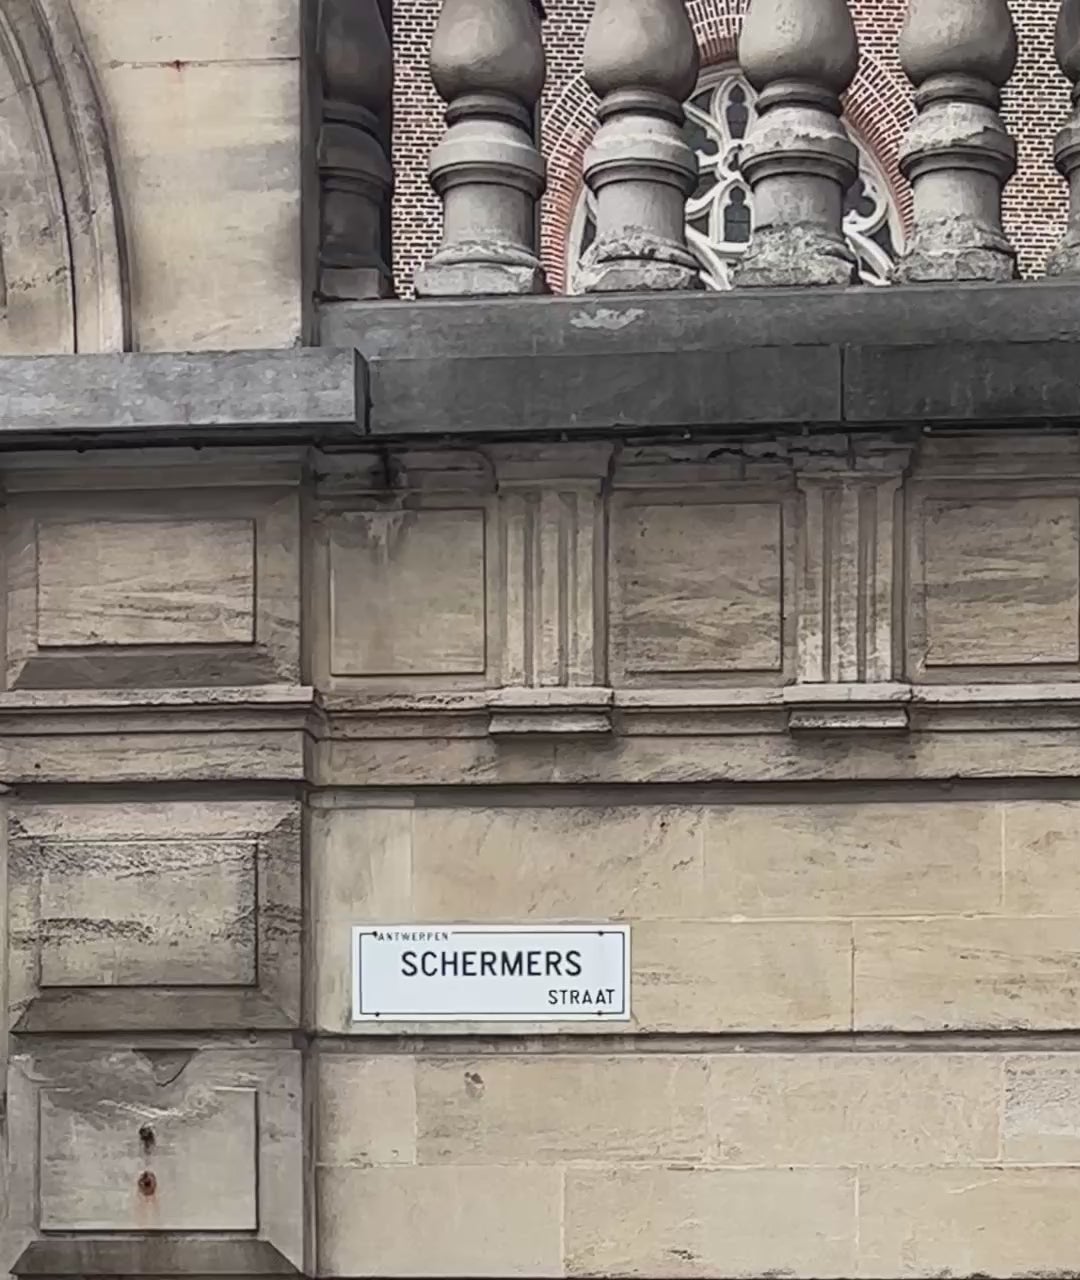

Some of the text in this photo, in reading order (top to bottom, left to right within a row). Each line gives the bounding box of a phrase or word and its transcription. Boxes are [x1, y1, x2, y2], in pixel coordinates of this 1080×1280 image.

[377, 931, 449, 942] ANTWERPEN
[401, 951, 582, 977] SCHERMERS
[548, 989, 615, 1005] STRAAT
